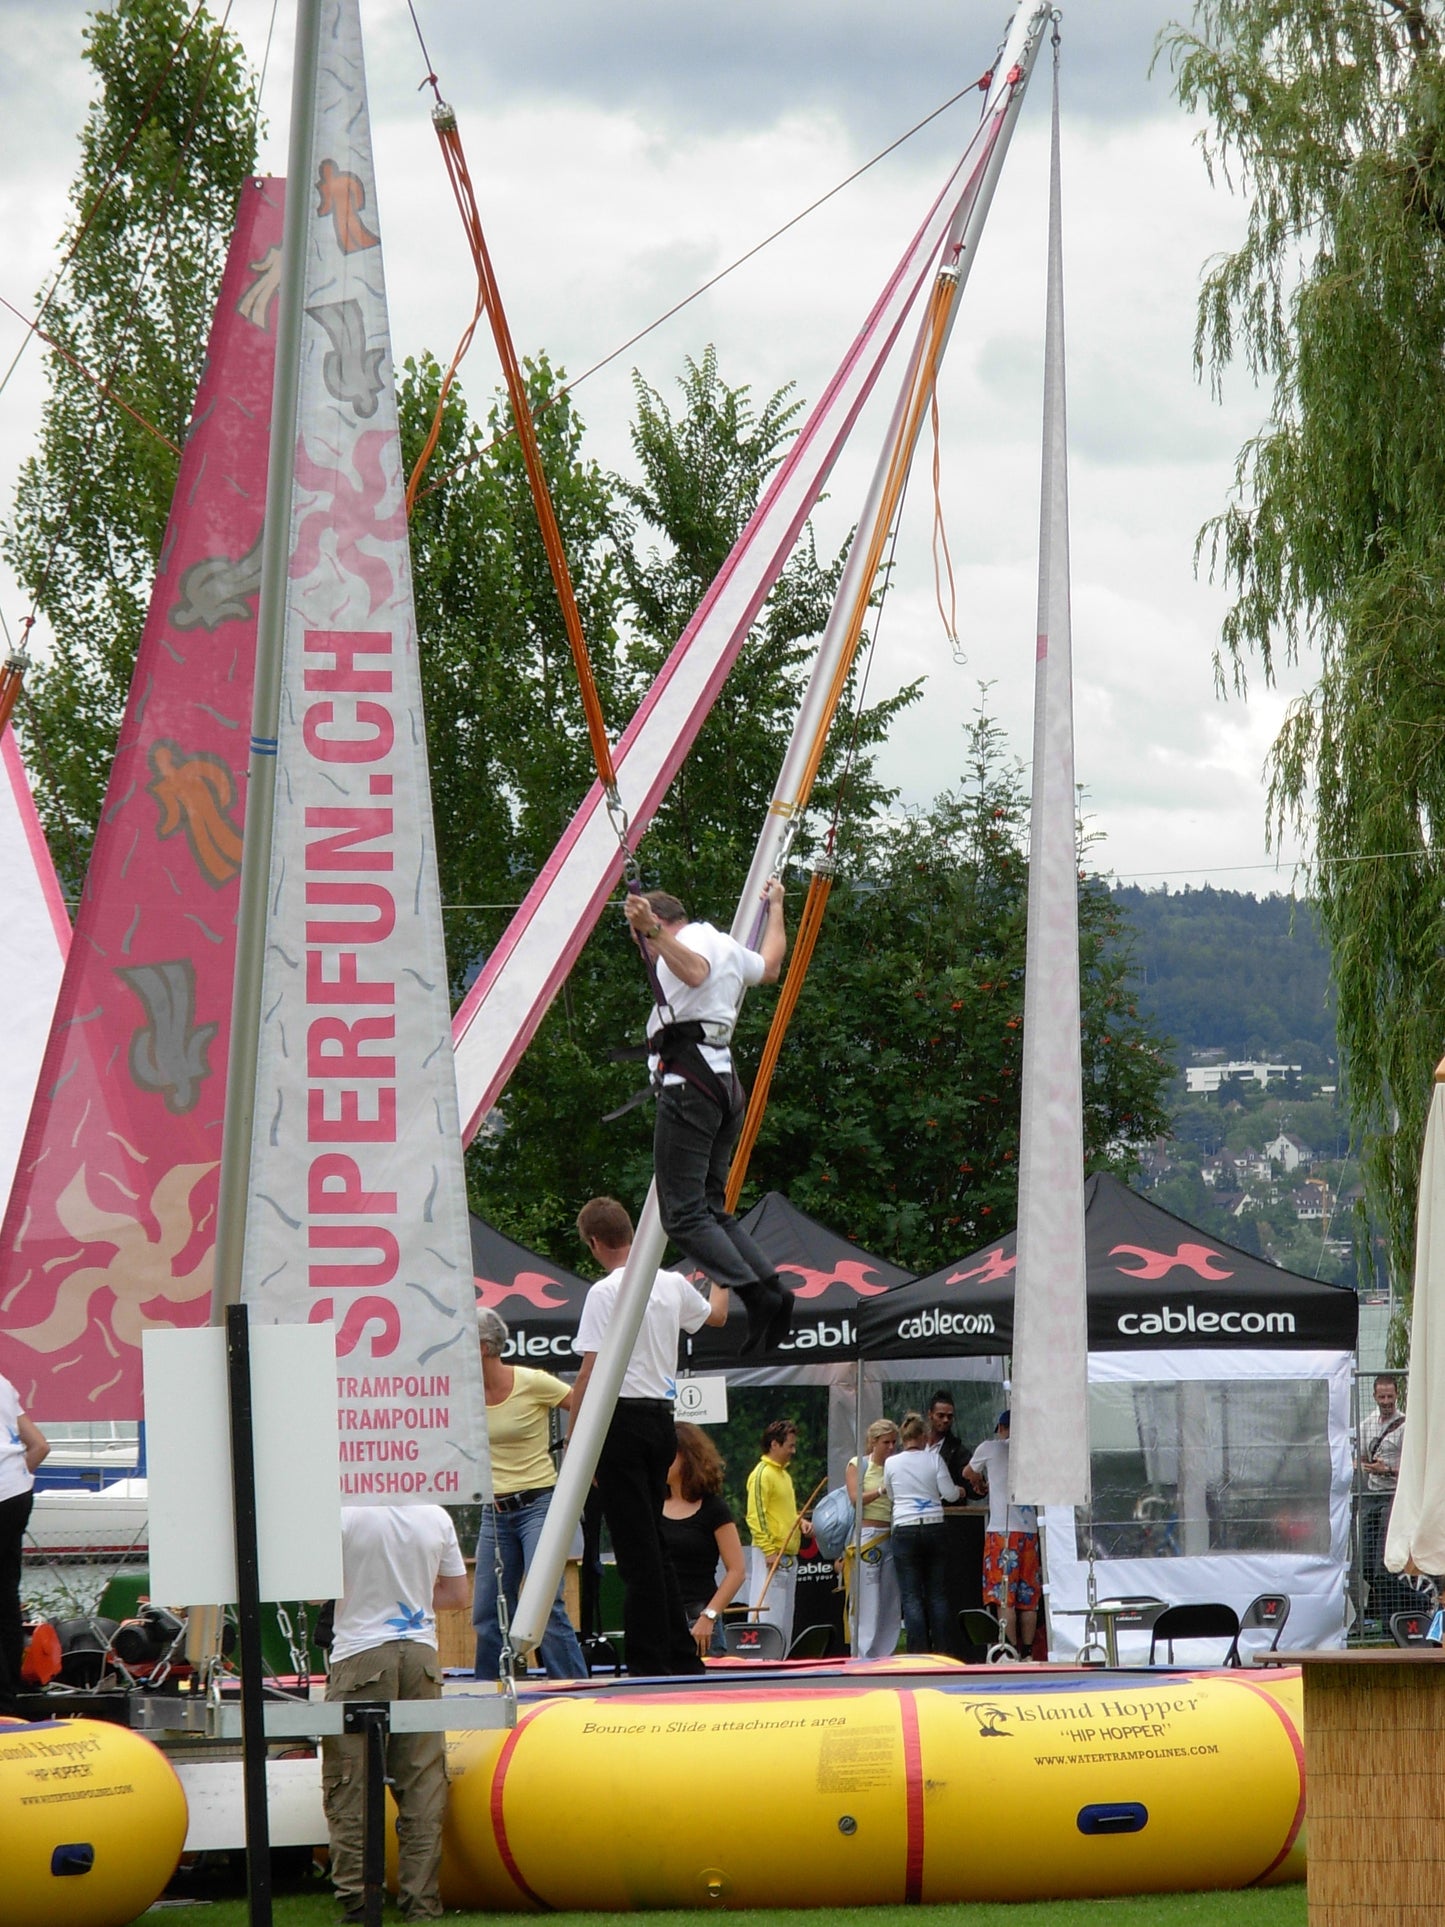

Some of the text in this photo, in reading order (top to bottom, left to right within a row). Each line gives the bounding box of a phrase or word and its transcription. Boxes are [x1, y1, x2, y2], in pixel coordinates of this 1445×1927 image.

[303, 629, 402, 1358] SUPERFUN.CH
[897, 1308, 995, 1339] cablecom
[1117, 1305, 1296, 1335] cablecom
[777, 1319, 857, 1349] cabl
[337, 1376, 450, 1398] TRAMPOLIN
[337, 1407, 449, 1430] TRAMPOLIN
[340, 1471, 459, 1495] LINSHOP.CH
[797, 1562, 834, 1575] able
[1015, 1698, 1200, 1722] Island Hopper
[582, 1716, 847, 1735] Bounce n Slide attachment area
[1033, 1744, 1219, 1766] WWW.WATERTRAMPOLINES.COM
